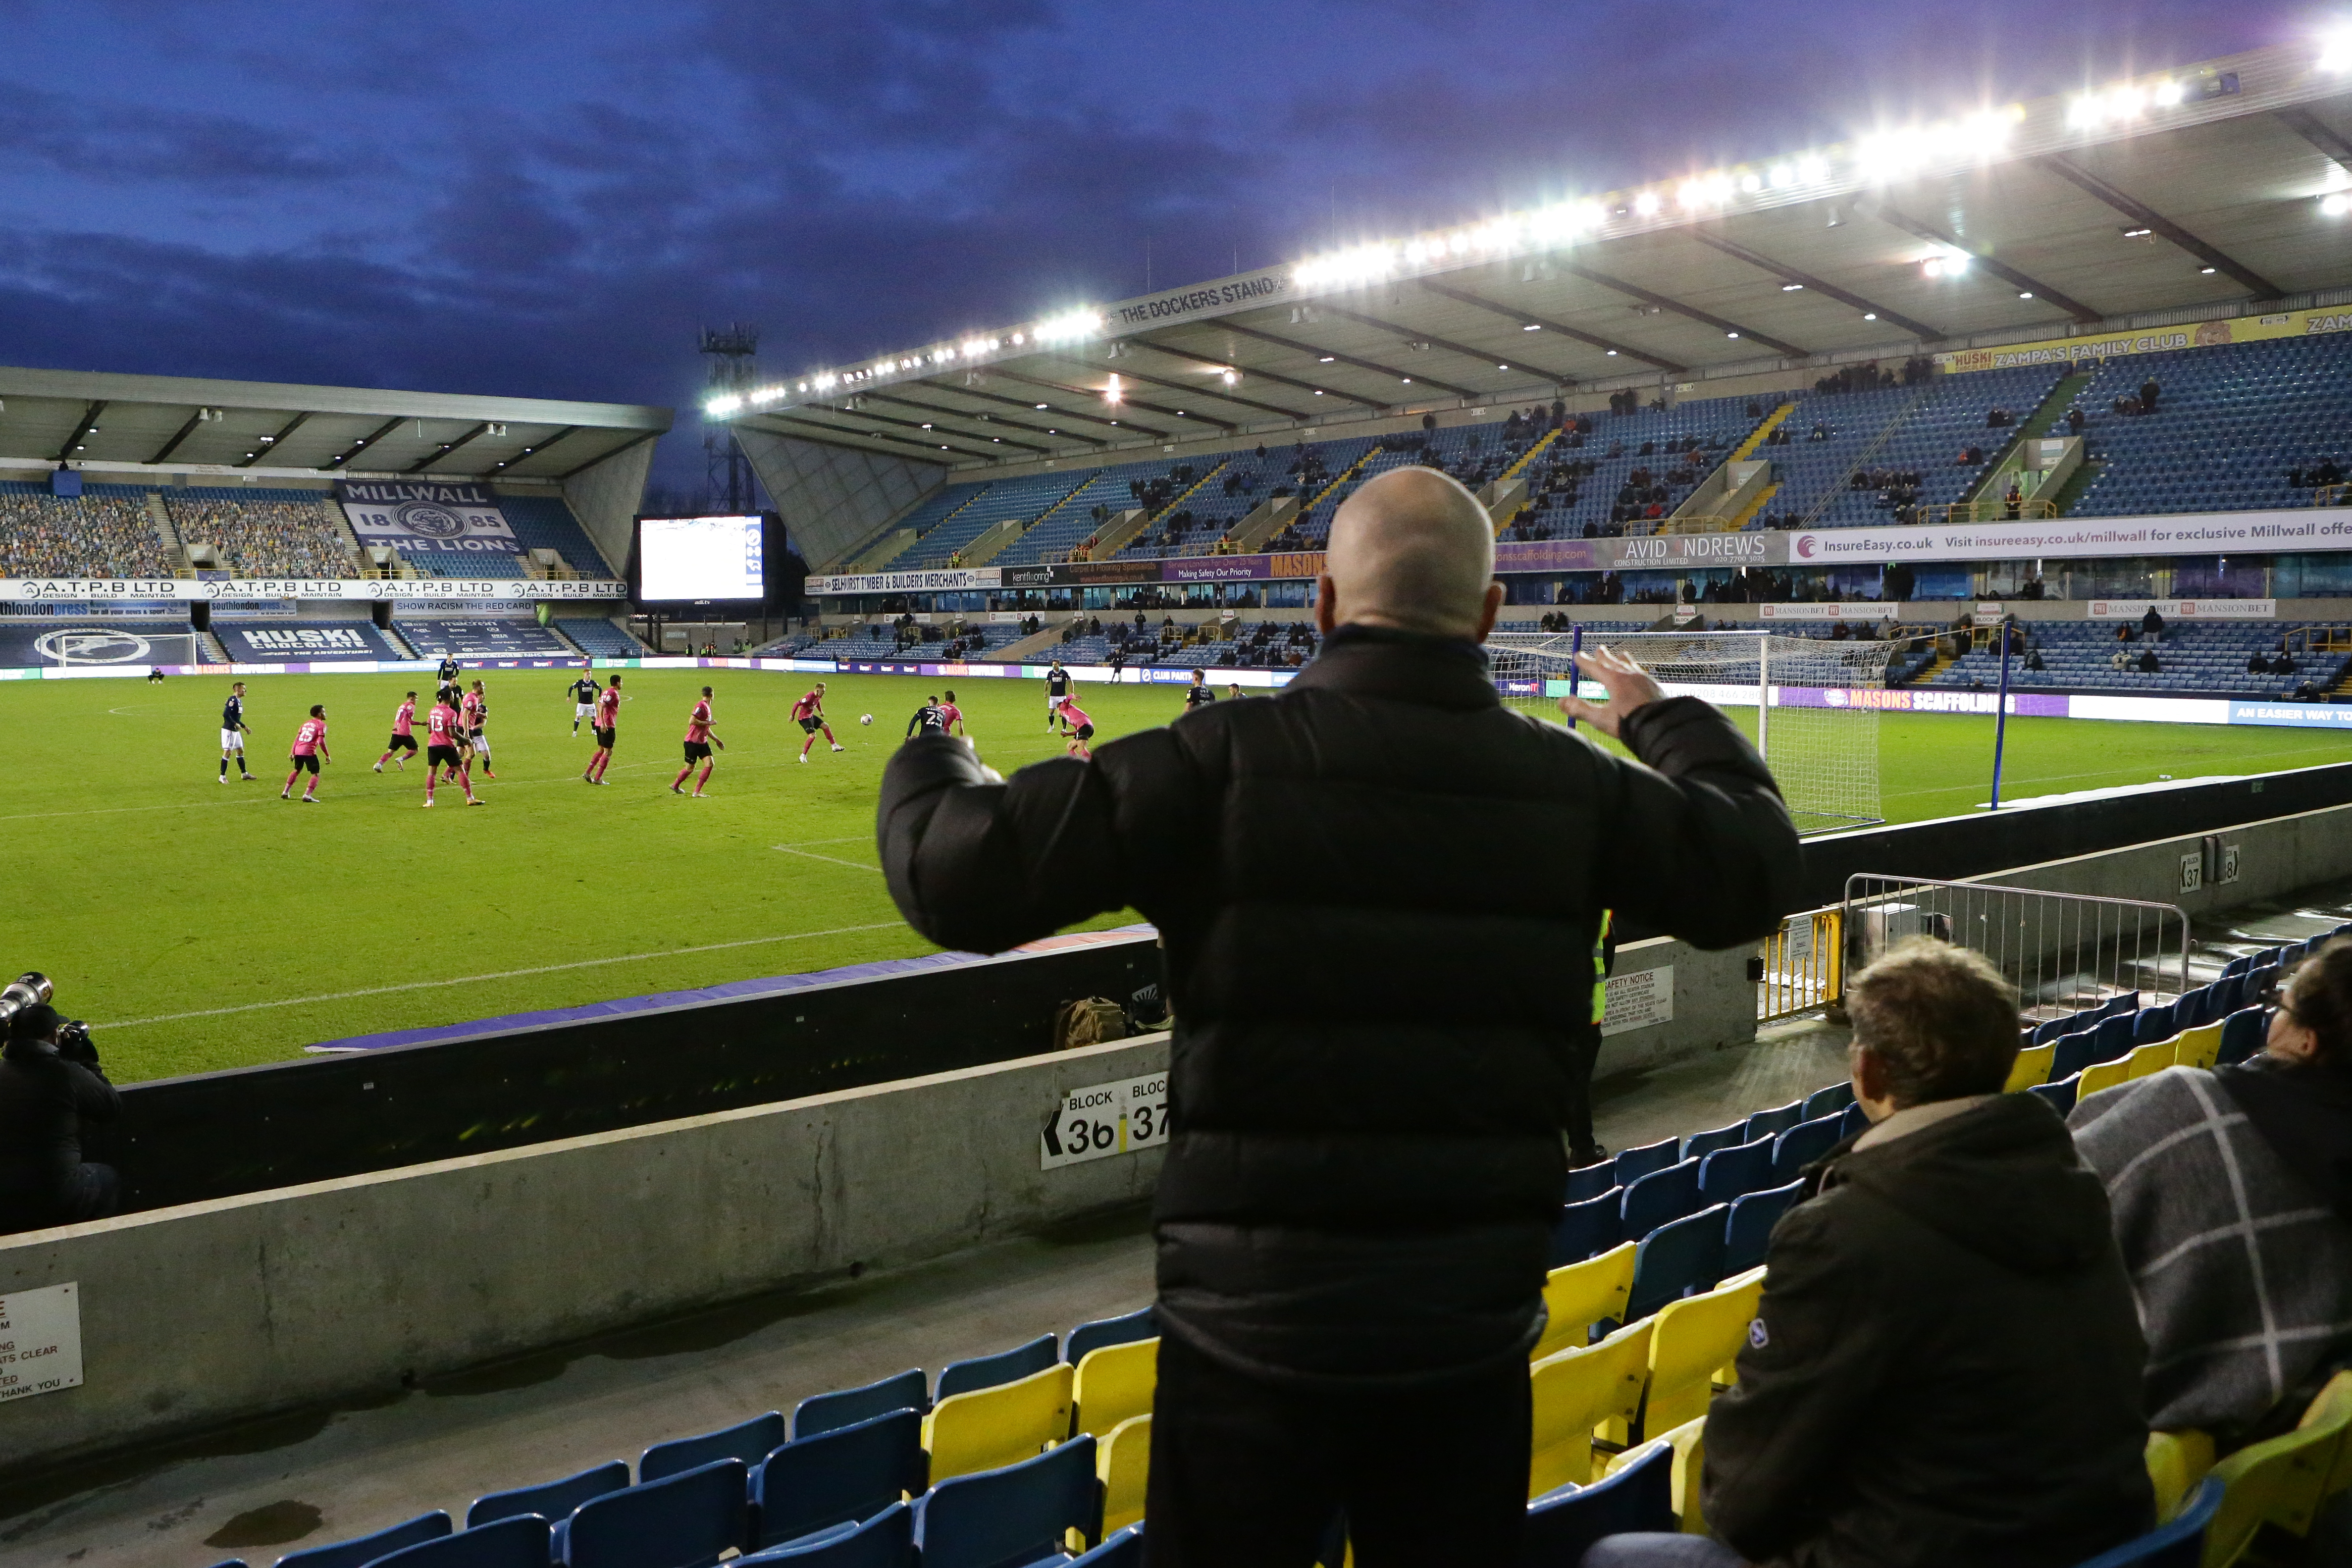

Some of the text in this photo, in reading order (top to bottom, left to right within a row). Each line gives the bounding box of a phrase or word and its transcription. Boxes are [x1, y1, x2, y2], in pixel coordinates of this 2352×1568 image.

[1119, 277, 1275, 324] THE DOCKERS STAND
[2307, 314, 2352, 332] ZAM
[1994, 346, 2066, 368] ZAMPA'S
[2071, 338, 2134, 358] FAMILY
[2136, 334, 2187, 351] CLUB
[1956, 351, 1992, 367] HUSKI
[345, 484, 487, 502] MILLWALL
[359, 513, 501, 528] 18 85
[1824, 521, 2352, 553] InsureEasy.co.uk Visit insureeasy.co.uk/millwall for exclusive Millwall offe
[368, 538, 520, 552] THE LIONS
[1614, 540, 1666, 559] AVID
[1069, 565, 1089, 573] Carpet
[1096, 564, 1121, 572] Flooring
[1123, 562, 1157, 571] Specialists
[1168, 561, 1187, 569] Serving
[1614, 557, 1688, 566] CONSTRUCTION LIMITED
[1178, 567, 1252, 579] Making Safety Our Priority
[43, 582, 175, 592] A.T.P.B LTD
[222, 582, 341, 592] A.T.P.B LTD
[385, 582, 494, 592] A.T.P.B LTD
[832, 577, 860, 591] SELHURST
[861, 576, 883, 590] TIMBER
[885, 578, 891, 589] &
[892, 574, 923, 589] BUILDERS
[925, 572, 967, 587] MERCHANTS
[527, 583, 627, 593] A.T.P.B LTD
[212, 601, 280, 611] southlondonpress
[2108, 605, 2176, 613] MANSIOBET
[2197, 604, 2270, 613] MANSIONBET
[241, 629, 363, 643] HUSKI
[250, 641, 368, 649] CHOCOLATE
[195, 664, 230, 674] MASONS
[1153, 671, 1170, 680] CLUB
[1508, 683, 1538, 692] HeronIT
[1690, 689, 1715, 698] 0208
[1719, 690, 1738, 699] 466
[1850, 690, 1911, 709] MASONS
[2237, 708, 2352, 721] AN EASIER WAY TO
[430, 715, 443, 732] 13
[2187, 868, 2199, 887] 37
[1630, 972, 1654, 984] NOTICE
[1069, 1080, 1165, 1110] BLOCK BLOC
[1067, 1102, 1170, 1155] 36 37
[21, 1345, 58, 1360] CLEAR
[38, 1378, 60, 1389] YOU
